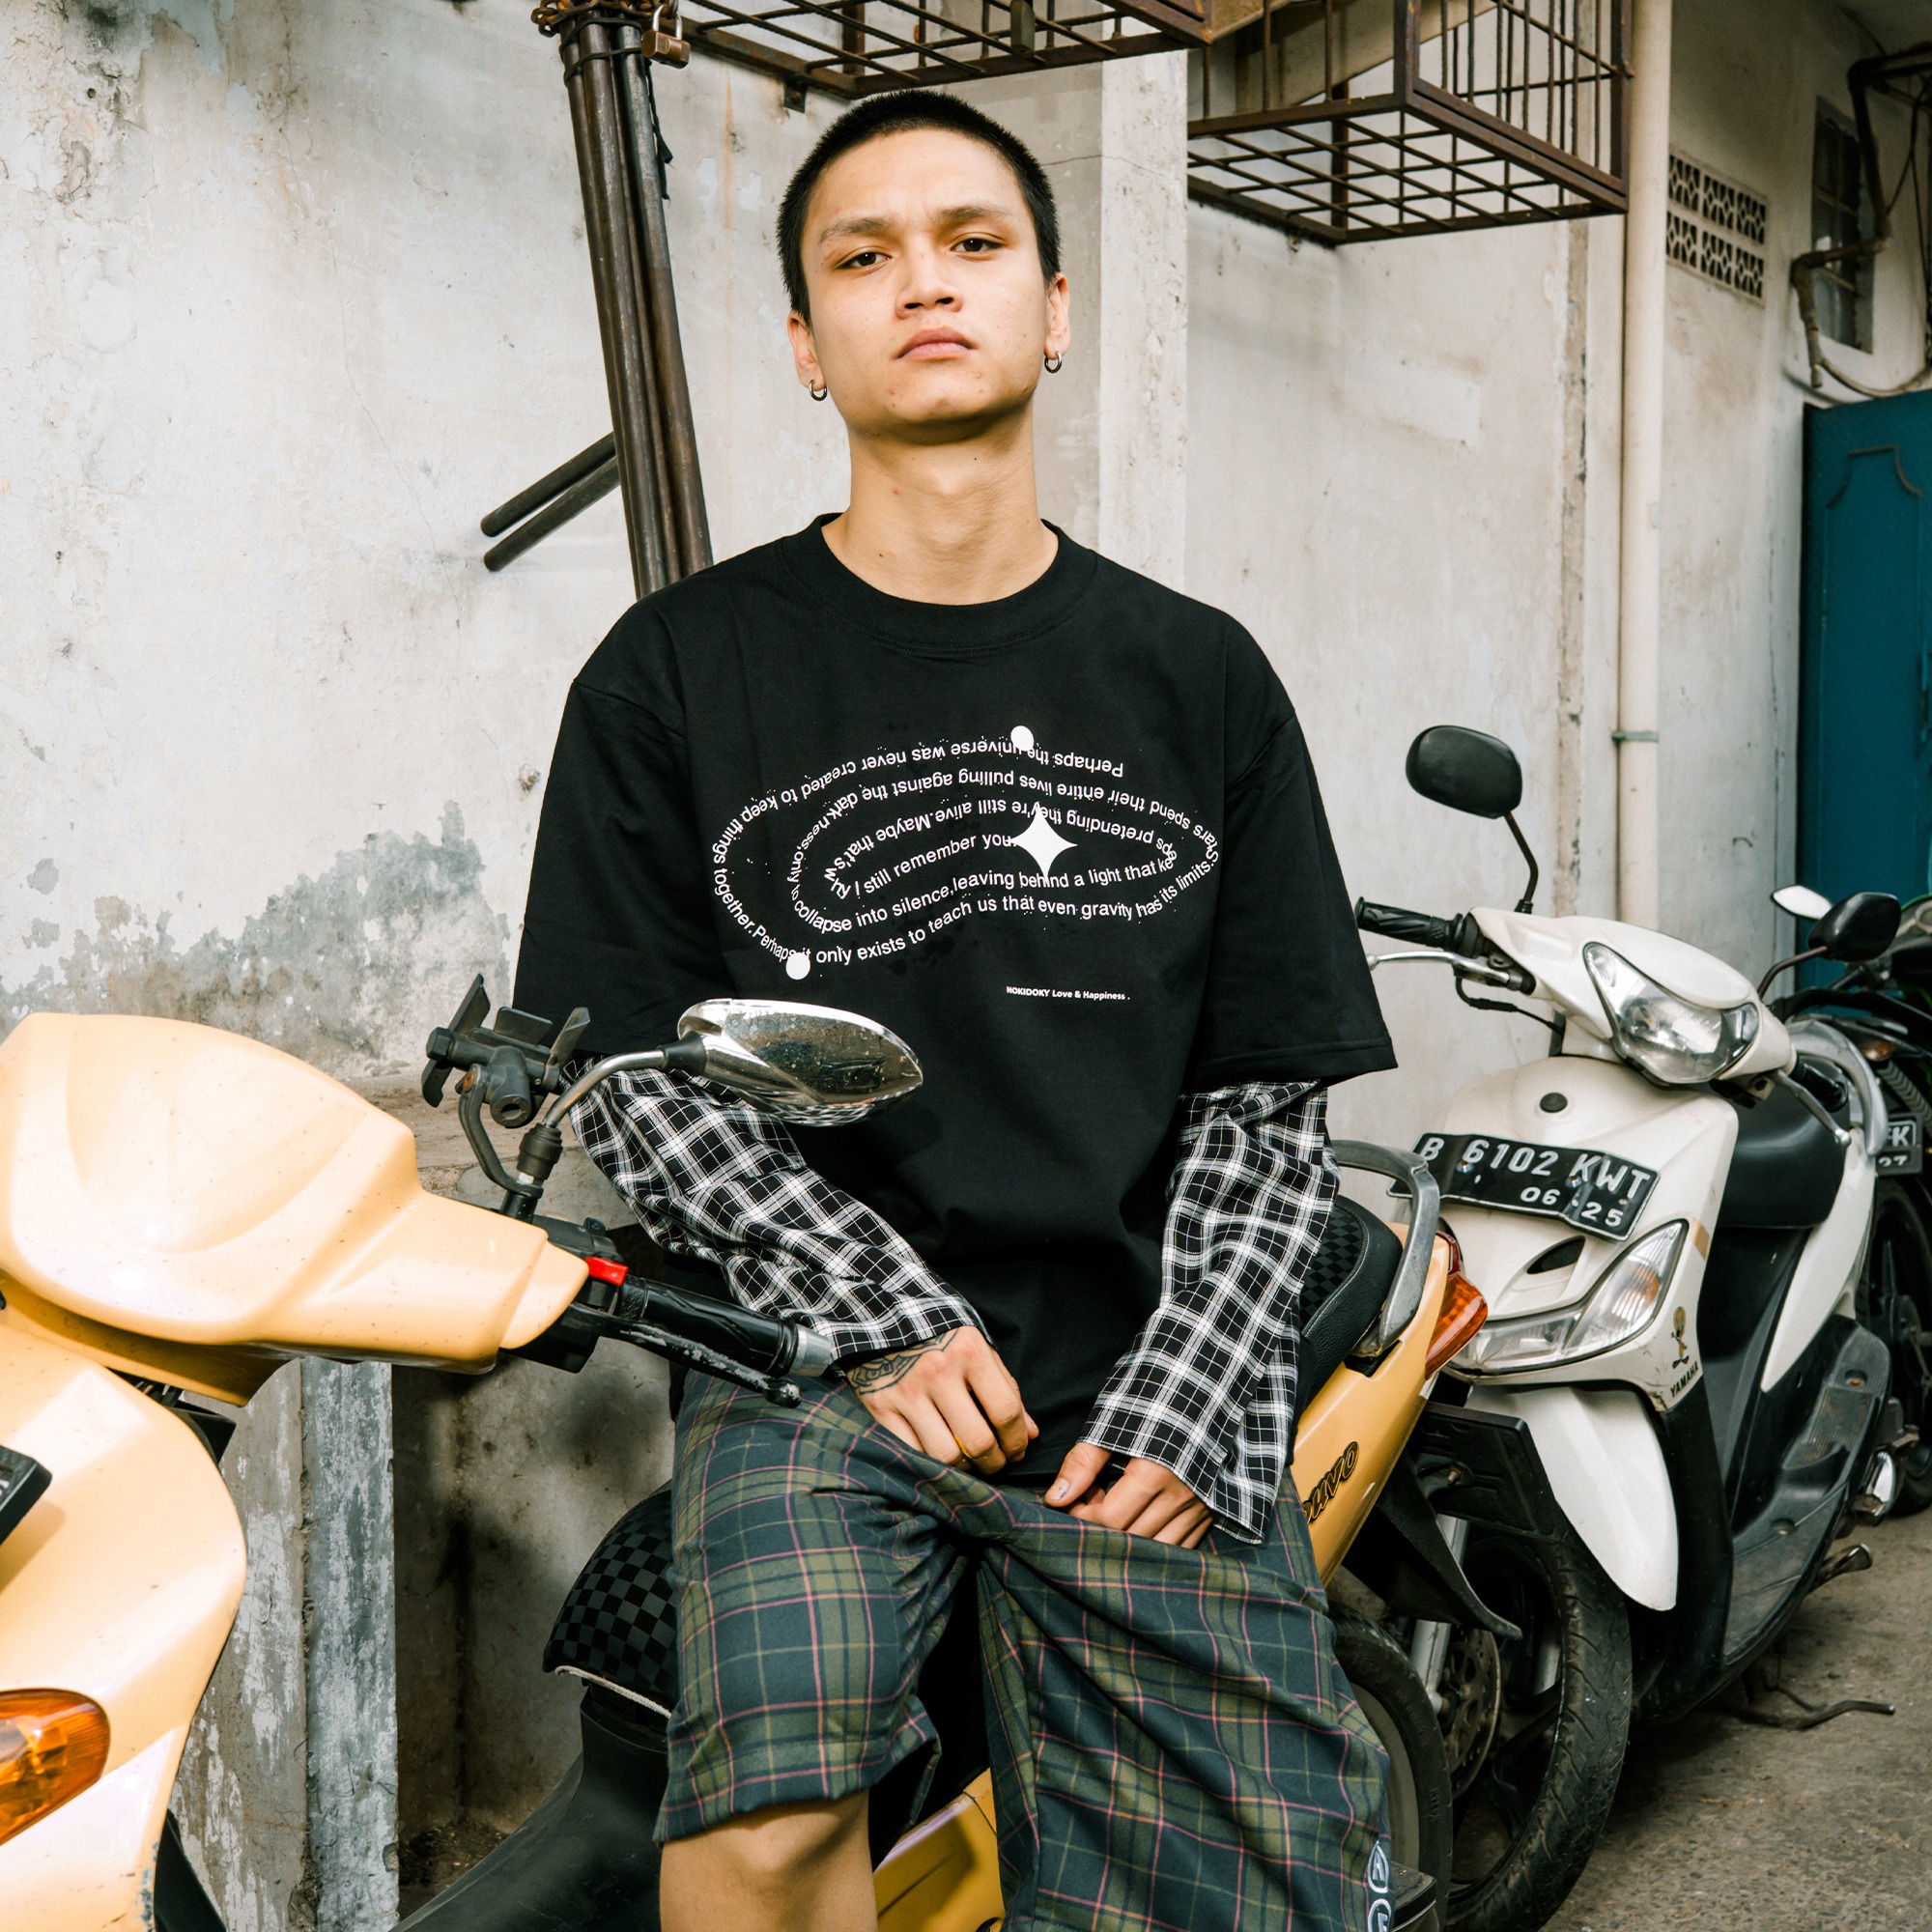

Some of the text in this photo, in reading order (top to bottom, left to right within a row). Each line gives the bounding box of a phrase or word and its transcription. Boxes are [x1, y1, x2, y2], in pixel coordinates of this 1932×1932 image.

[862, 751, 907, 771] never
[911, 746, 946, 761] was
[1027, 748, 1050, 765] the
[1054, 752, 1123, 778] Perhaps
[801, 761, 856, 799] created
[892, 772, 953, 797] against
[958, 768, 1014, 786] pulling
[1019, 775, 1052, 797] lives
[781, 788, 798, 804] to
[862, 785, 889, 801] the
[1057, 782, 1104, 801] entire
[1110, 789, 1146, 812] their
[740, 795, 779, 822] keep
[978, 799, 1007, 815] still
[1150, 800, 1191, 829] spend
[1066, 809, 1154, 844] pretending
[712, 818, 745, 865] things
[834, 836, 875, 869] that's
[894, 836, 977, 877] remember
[1018, 871, 1069, 889] behind
[1073, 874, 1085, 887] a
[1088, 868, 1122, 887] light
[1124, 860, 1157, 881] that
[863, 868, 892, 895] still
[1003, 895, 1035, 911] that
[1159, 885, 1178, 903] its
[978, 898, 997, 912] us
[1037, 899, 1076, 916] even
[1081, 901, 1133, 921] gravity
[1135, 897, 1163, 918] has
[794, 900, 853, 934] collapse
[855, 908, 888, 927] into
[928, 901, 972, 933] teach
[908, 928, 925, 945] to
[816, 945, 852, 965] only
[857, 937, 906, 960] exists
[1052, 989, 1073, 999] Love
[1074, 990, 1082, 999] &
[1419, 1137, 1651, 1201] B 6102 KWT
[1669, 1360, 1699, 1399] YAMAHA
